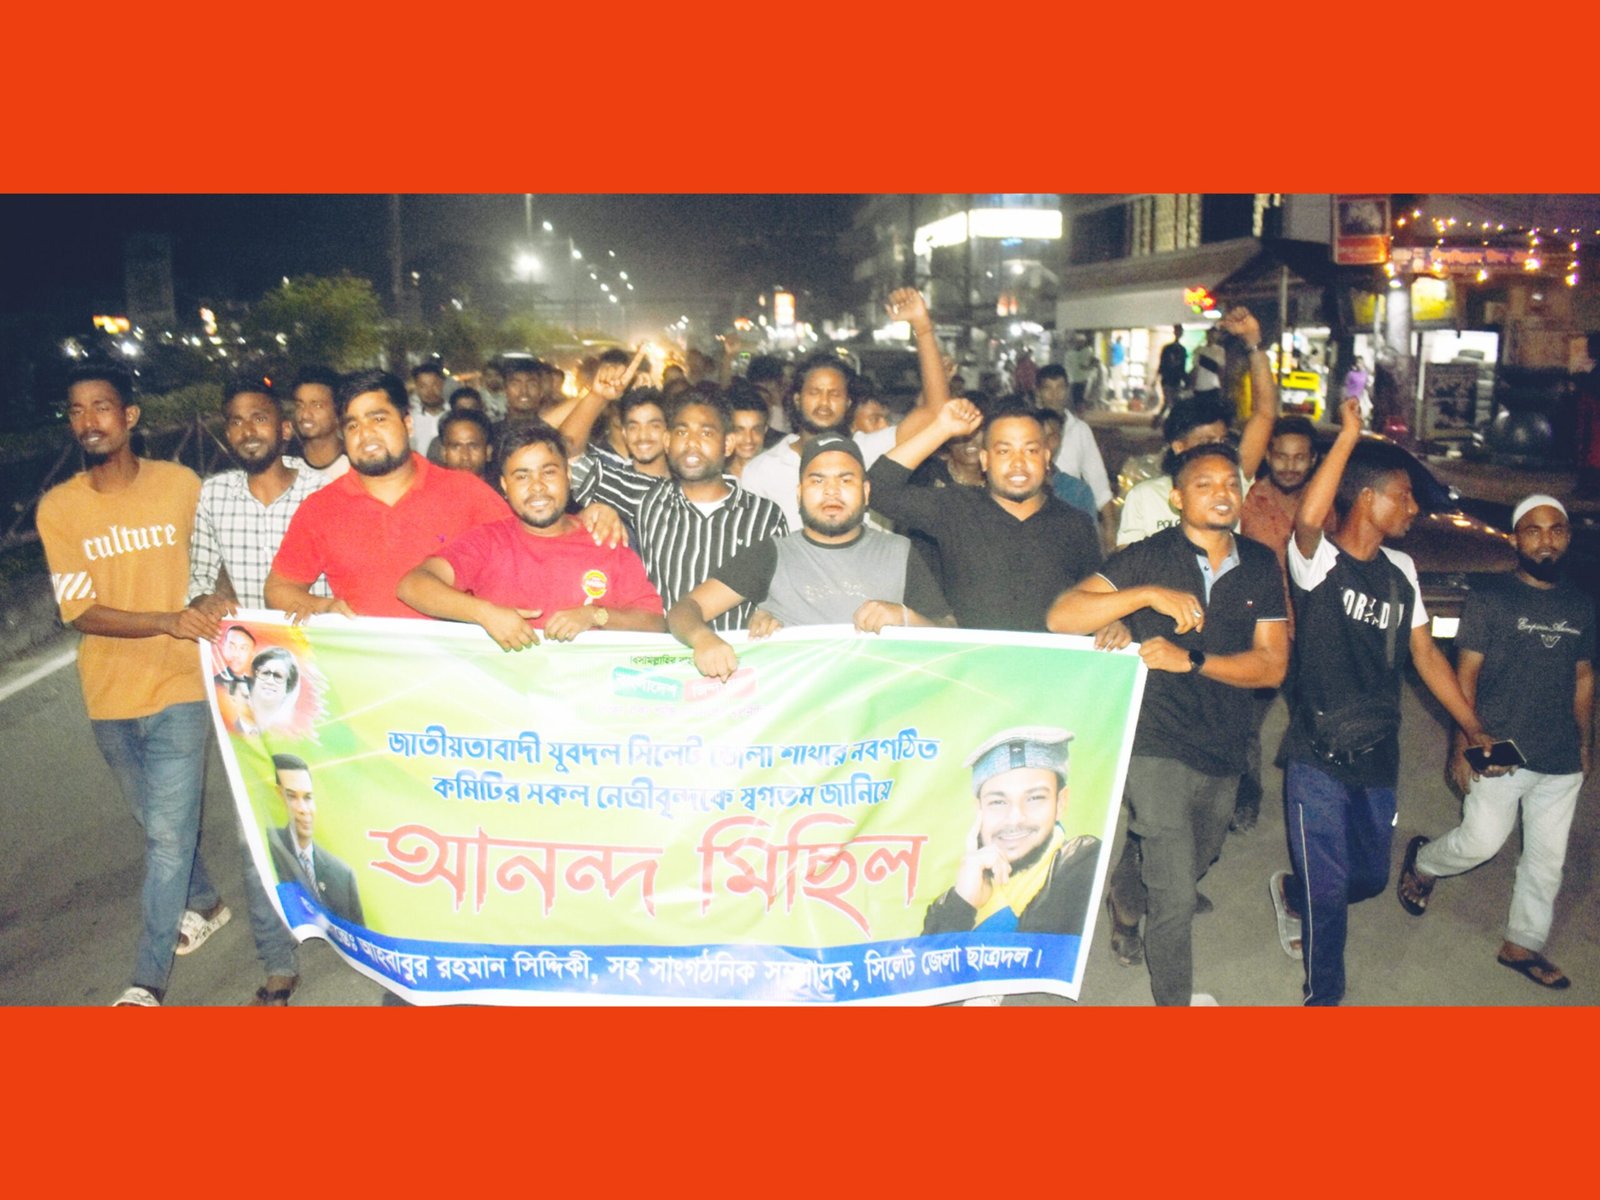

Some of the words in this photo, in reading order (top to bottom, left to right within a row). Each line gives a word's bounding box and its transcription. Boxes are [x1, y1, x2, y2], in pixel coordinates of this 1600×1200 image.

[82, 522, 178, 562] culture
[388, 725, 541, 764] জাতীয়তাবাদী
[548, 742, 622, 774] যুবদল
[627, 734, 703, 768] সিলেট
[780, 744, 847, 767] শাখার
[850, 728, 941, 763] নবগঠিত
[432, 769, 521, 804] কমিটির
[526, 783, 590, 807] সকল
[819, 773, 894, 807] জানিয়ে
[368, 823, 665, 918] আনন্দ
[697, 812, 929, 939] মিছিল
[434, 955, 508, 982] রহমান
[512, 950, 599, 985] সিদ্দিকী,
[606, 956, 643, 985] সহ
[648, 948, 757, 986] সাংগঠনিক
[864, 946, 917, 984] সিলেট
[921, 945, 963, 976] জেলা
